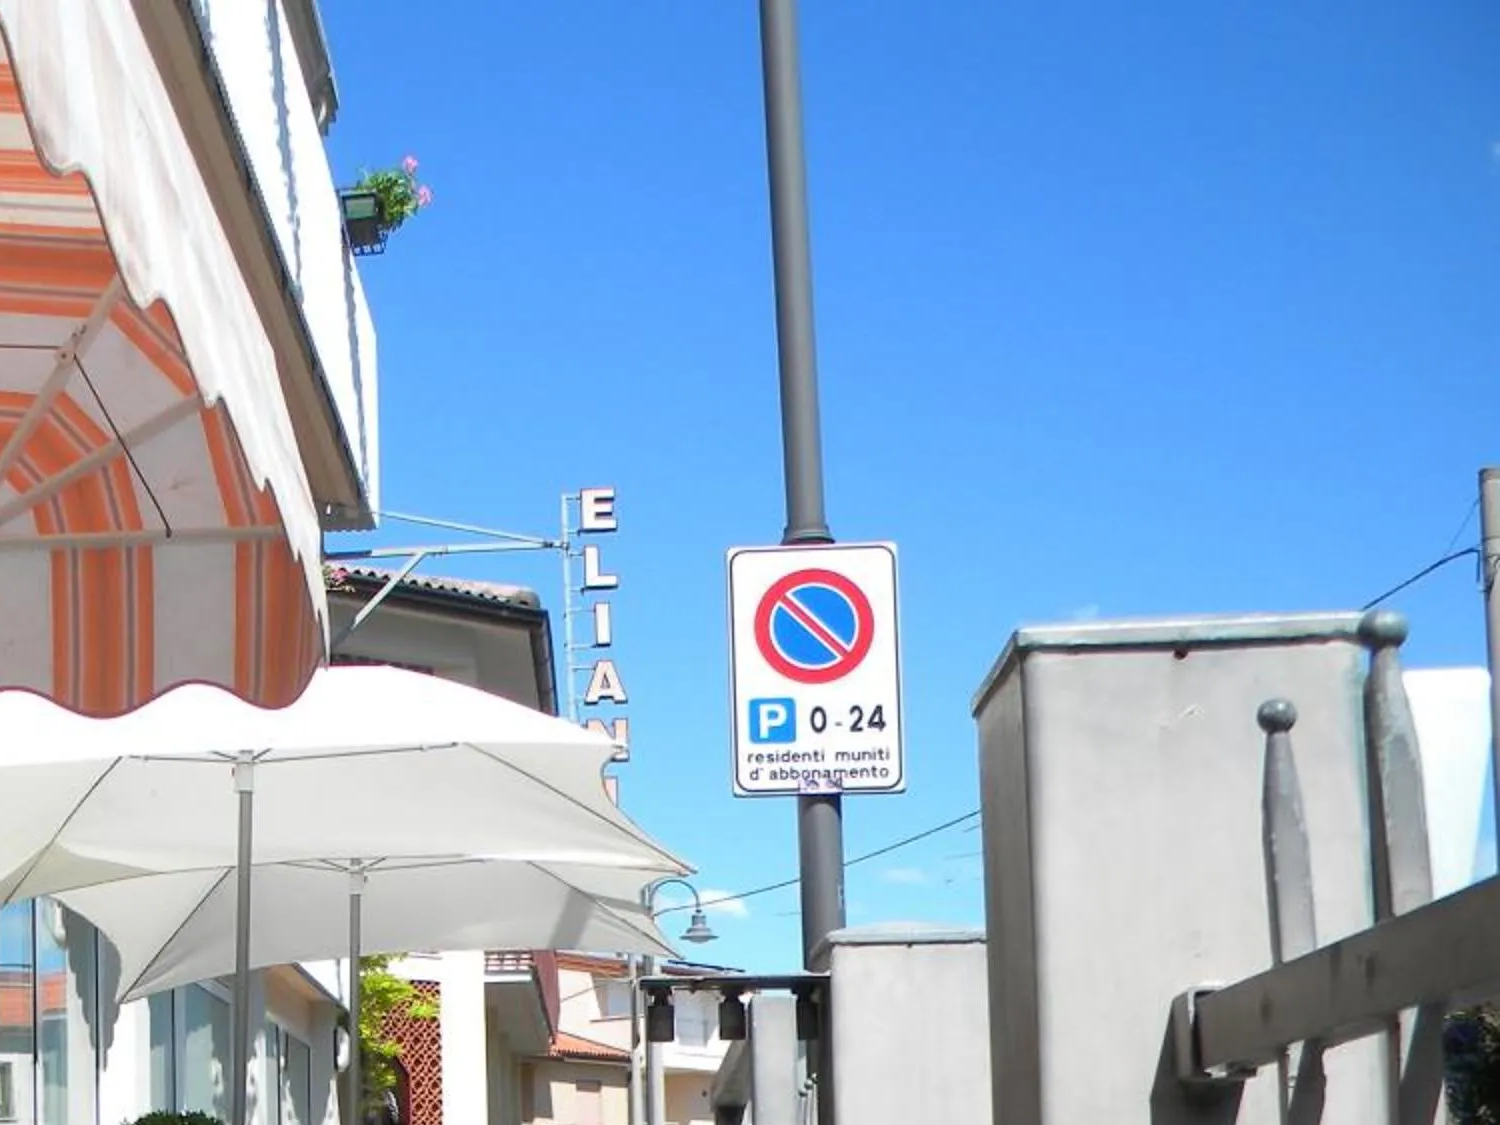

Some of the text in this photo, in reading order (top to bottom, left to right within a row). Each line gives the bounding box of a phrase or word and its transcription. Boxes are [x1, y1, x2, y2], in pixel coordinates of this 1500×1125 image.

[759, 703, 788, 739] P
[747, 746, 891, 764] residenti muniti
